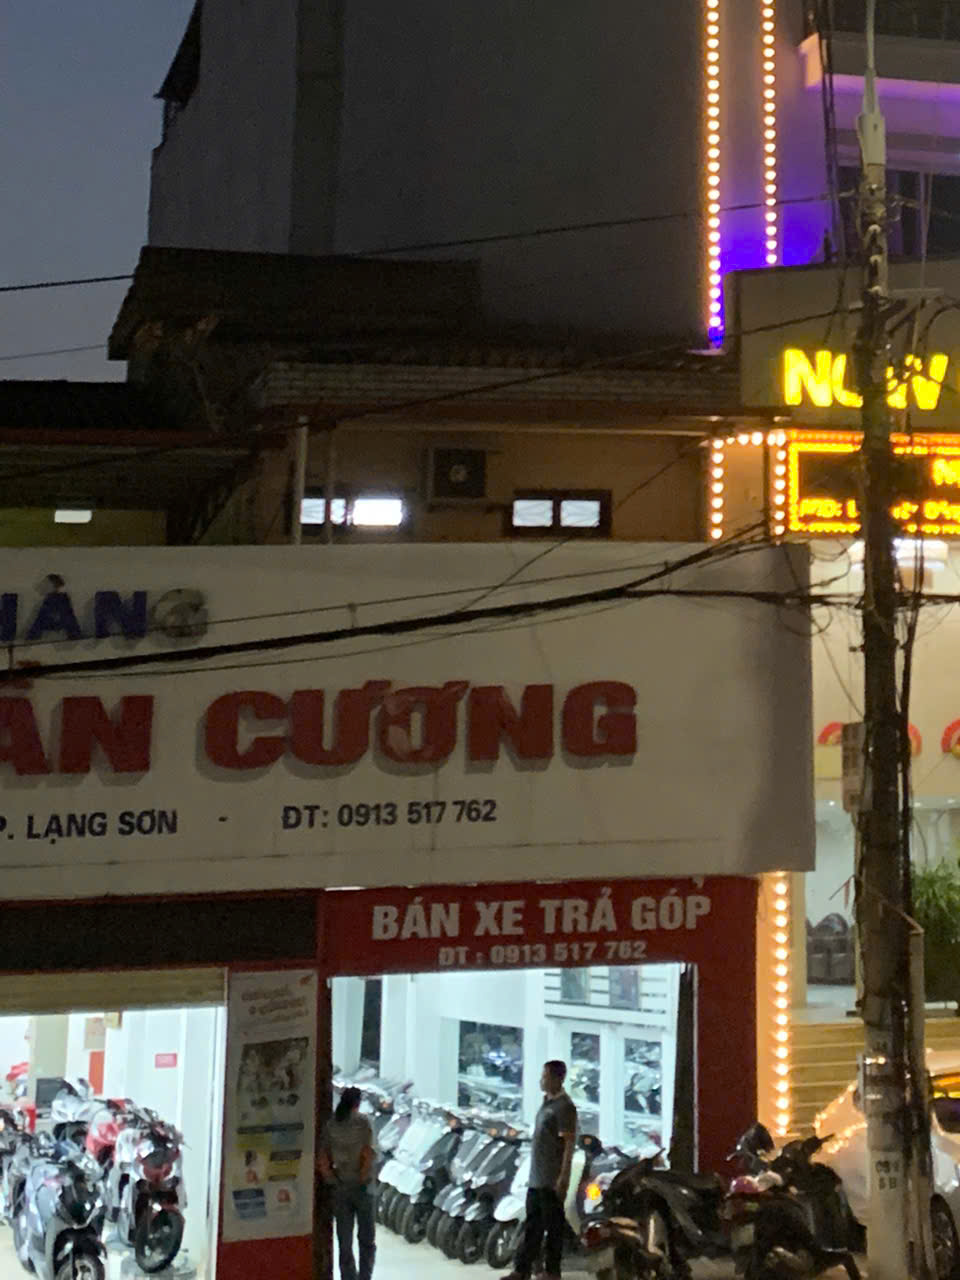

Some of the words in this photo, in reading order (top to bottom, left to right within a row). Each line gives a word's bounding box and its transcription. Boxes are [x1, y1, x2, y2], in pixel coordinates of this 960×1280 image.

[27, 811, 107, 845] LẠNG
[118, 809, 178, 836] SƠN
[281, 805, 329, 830] ĐT:
[337, 802, 399, 827] 0913
[406, 800, 447, 825] 517
[452, 799, 498, 823] 762
[371, 896, 460, 941] BÁN
[474, 900, 525, 937] XE
[539, 886, 618, 935] TRẢ
[631, 887, 712, 932] GÓP
[490, 943, 547, 964] 0913
[554, 941, 598, 961] 517
[605, 940, 648, 960] 762
